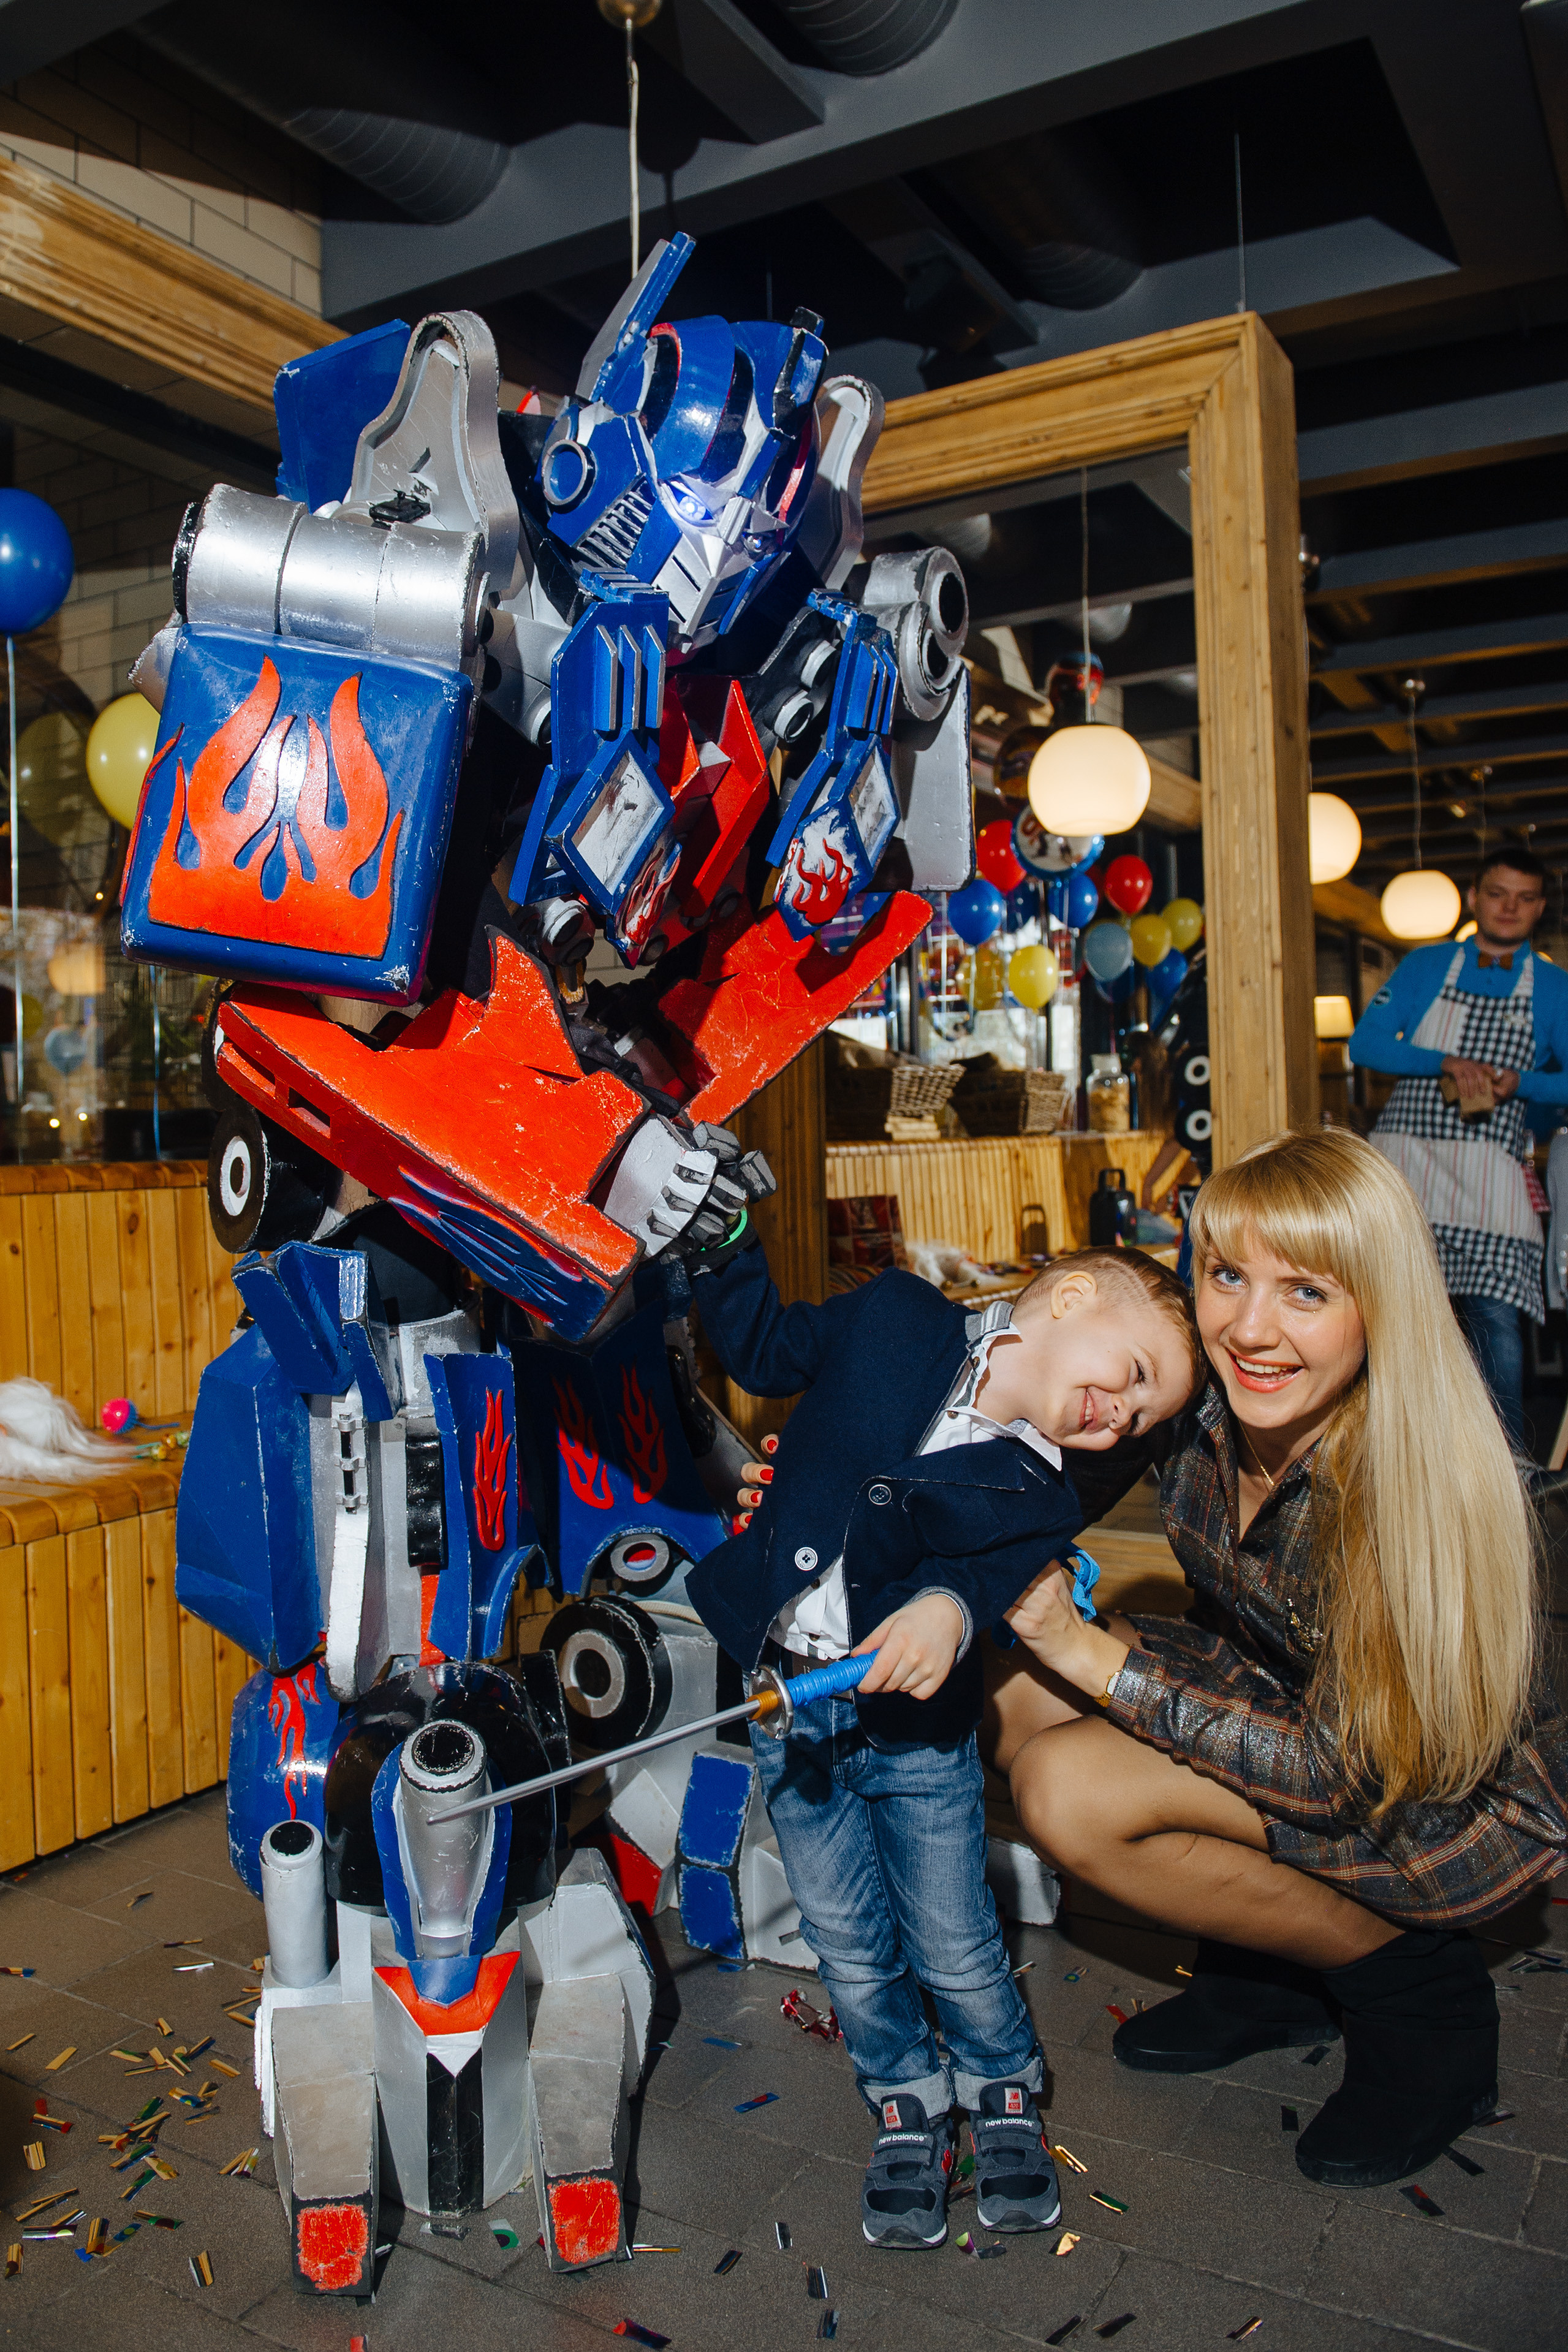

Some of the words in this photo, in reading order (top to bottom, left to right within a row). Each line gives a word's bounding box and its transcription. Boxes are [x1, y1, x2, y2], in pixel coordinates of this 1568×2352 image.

[985, 2119, 1001, 2128] new
[1002, 2117, 1032, 2127] balance
[879, 2135, 892, 2145] new
[892, 2133, 925, 2142] balance
